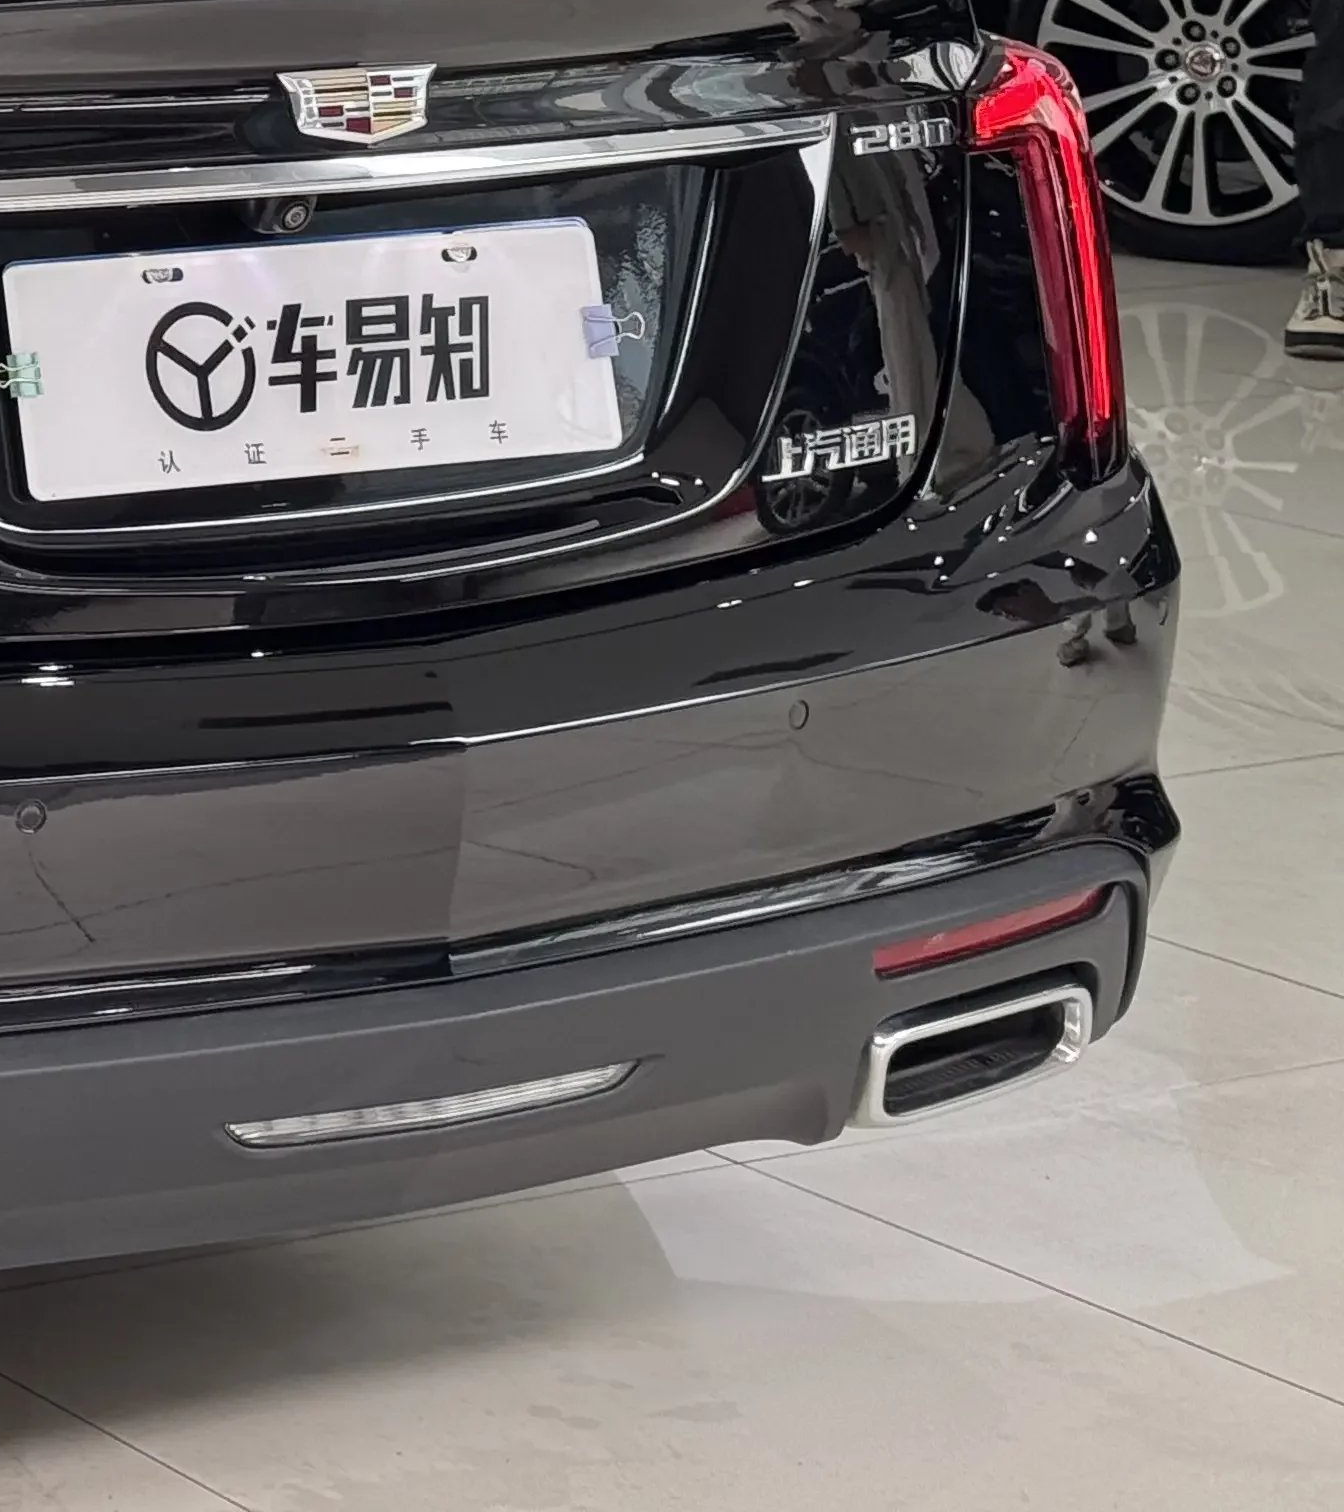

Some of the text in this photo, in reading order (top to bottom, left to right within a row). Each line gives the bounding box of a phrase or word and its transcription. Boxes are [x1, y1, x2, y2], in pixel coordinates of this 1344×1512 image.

[266, 292, 490, 414] 车易知
[157, 419, 510, 476] 认证二手车
[761, 414, 916, 482] 上汽通用
